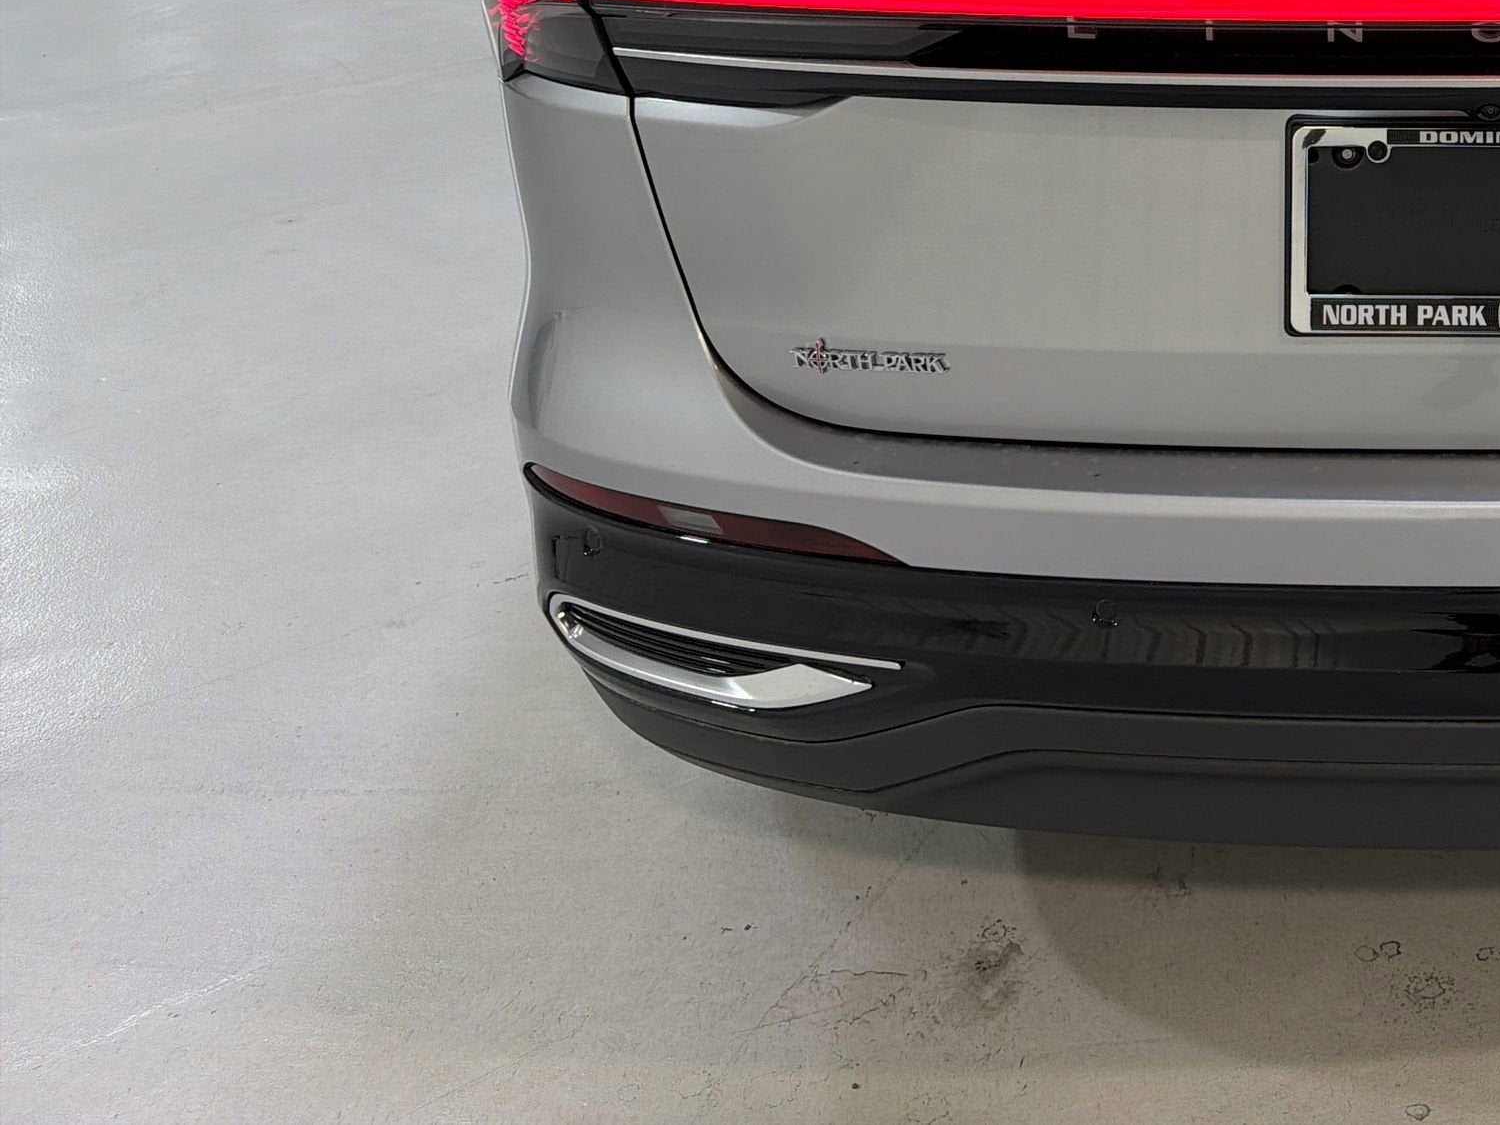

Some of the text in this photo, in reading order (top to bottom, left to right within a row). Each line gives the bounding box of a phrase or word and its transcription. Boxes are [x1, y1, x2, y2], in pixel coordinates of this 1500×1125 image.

[1322, 304, 1407, 326] NORTH
[1417, 304, 1488, 327] PARK
[790, 345, 950, 374] NORTH PARK
